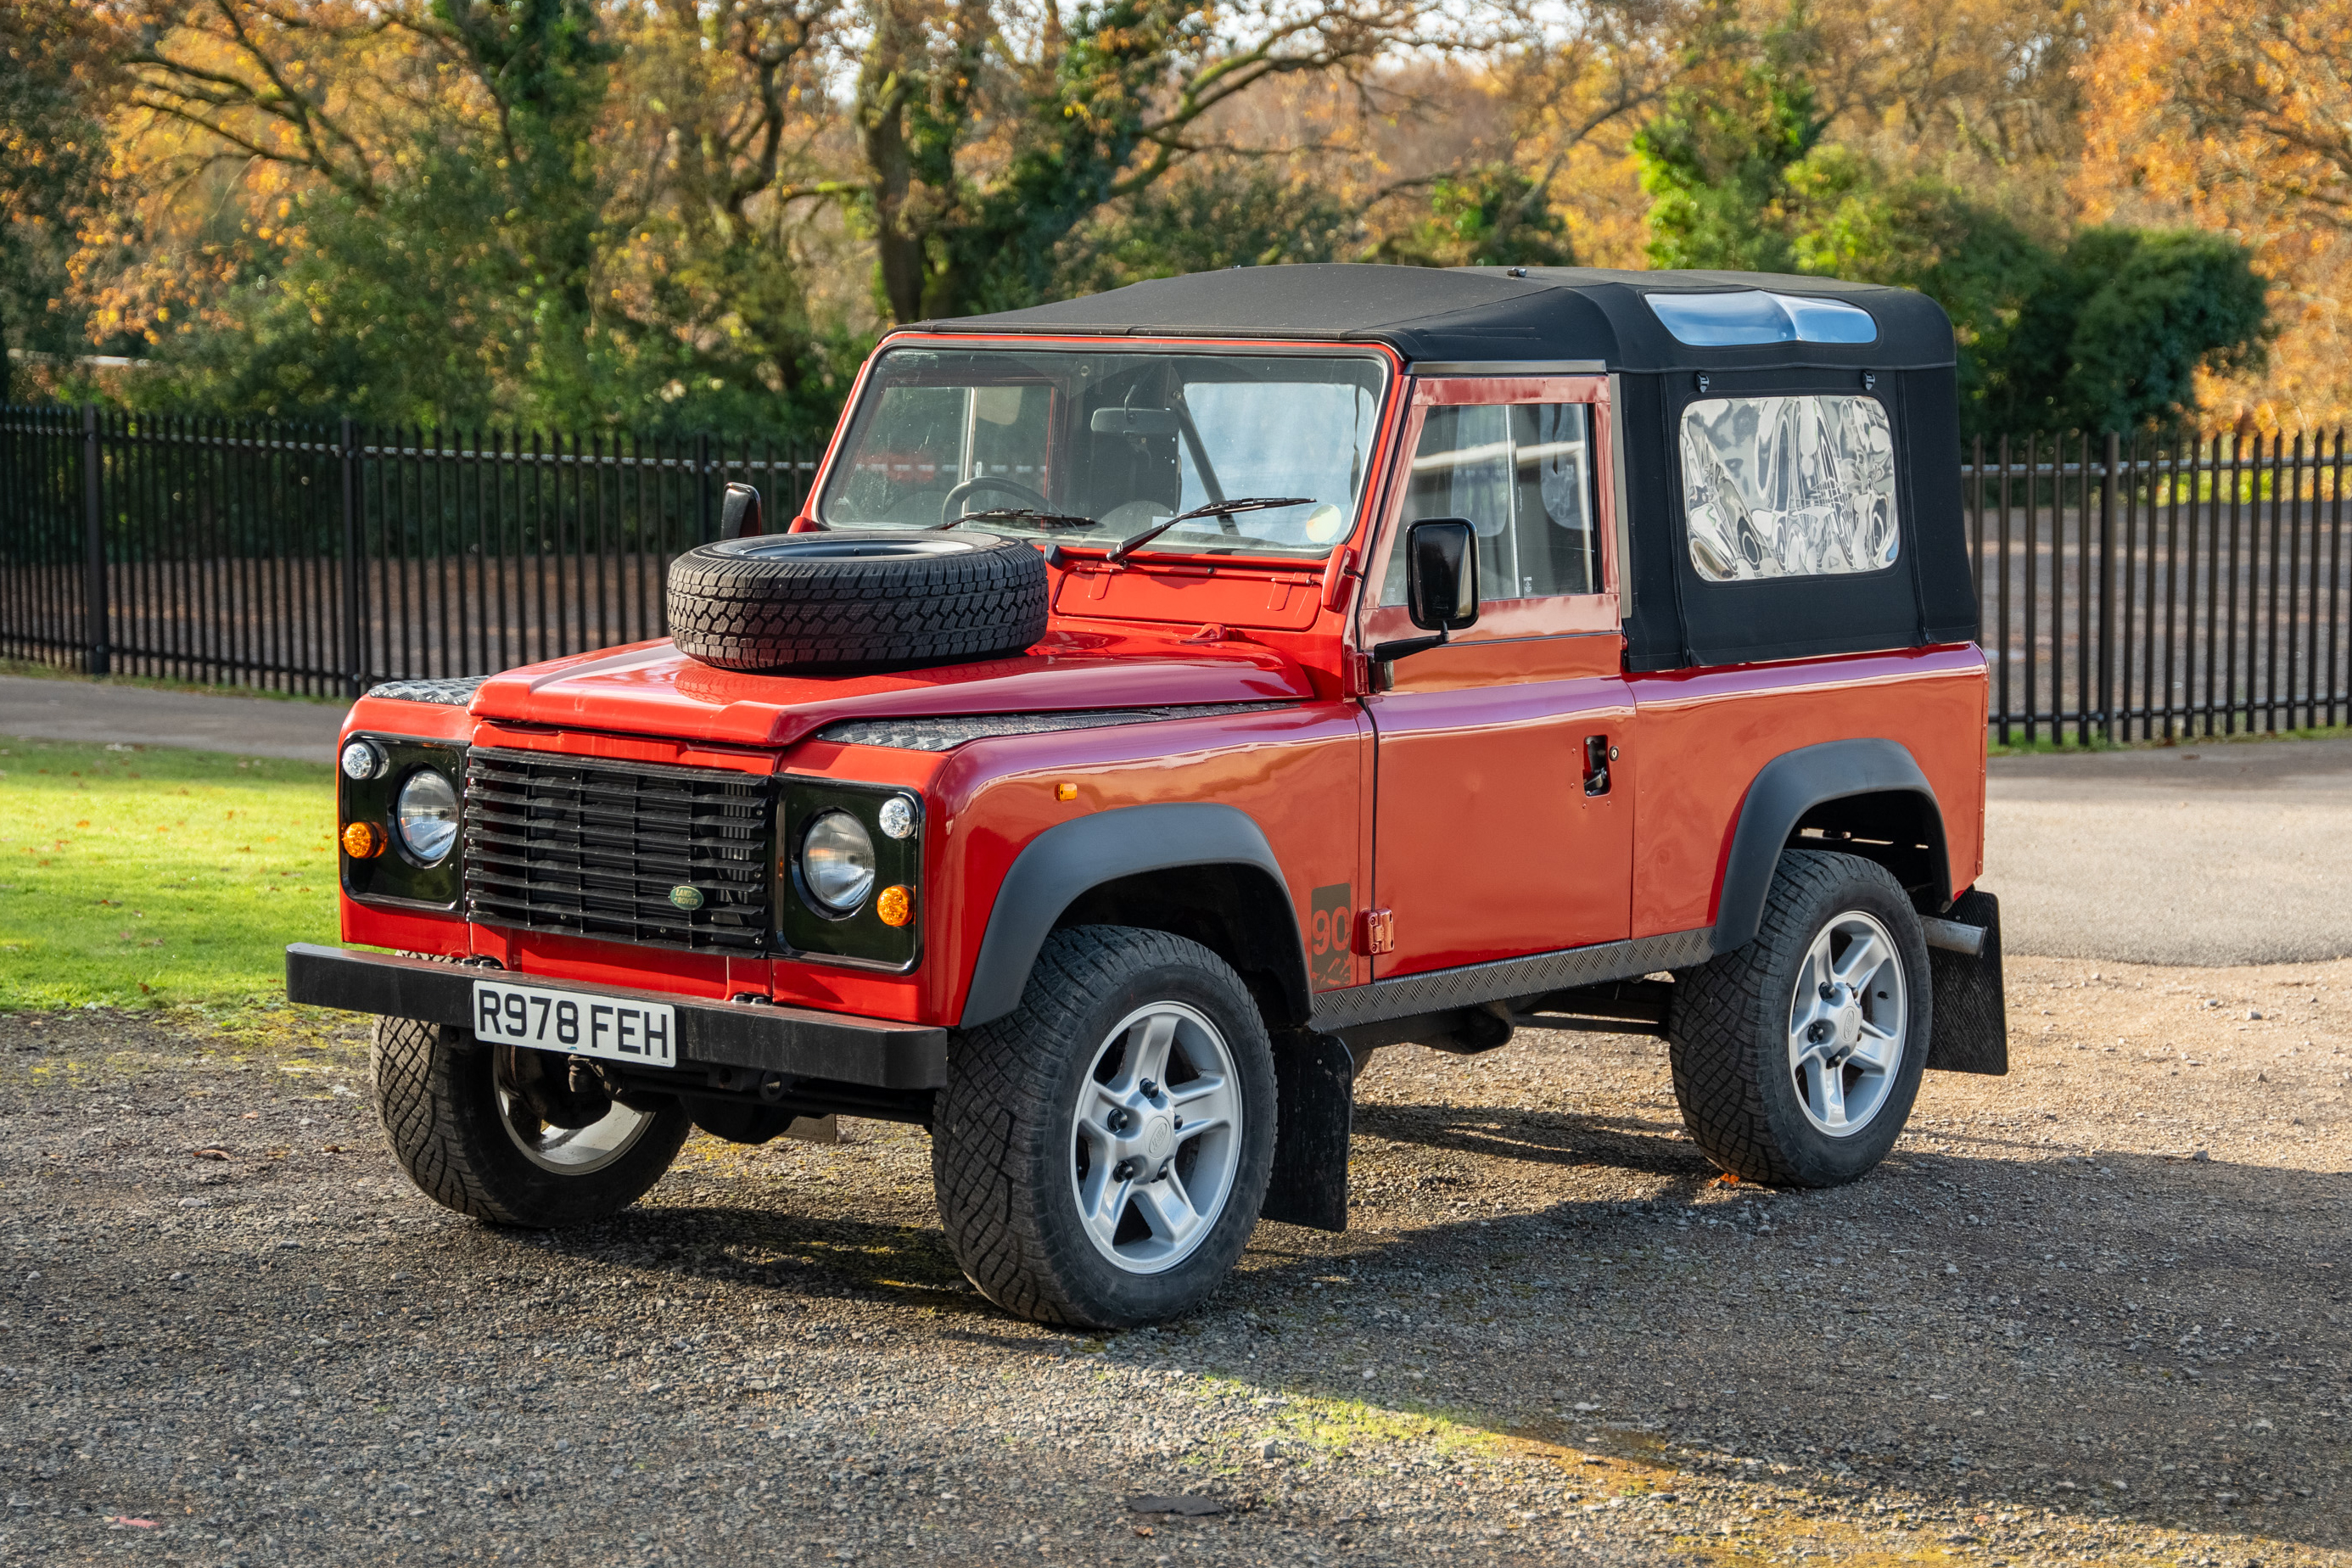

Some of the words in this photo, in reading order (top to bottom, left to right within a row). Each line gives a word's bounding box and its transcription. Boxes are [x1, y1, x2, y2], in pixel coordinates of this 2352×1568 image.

[676, 897, 698, 905] ROVER
[1312, 906, 1351, 956] 90
[479, 988, 580, 1044] R978
[591, 1004, 669, 1059] FEH
